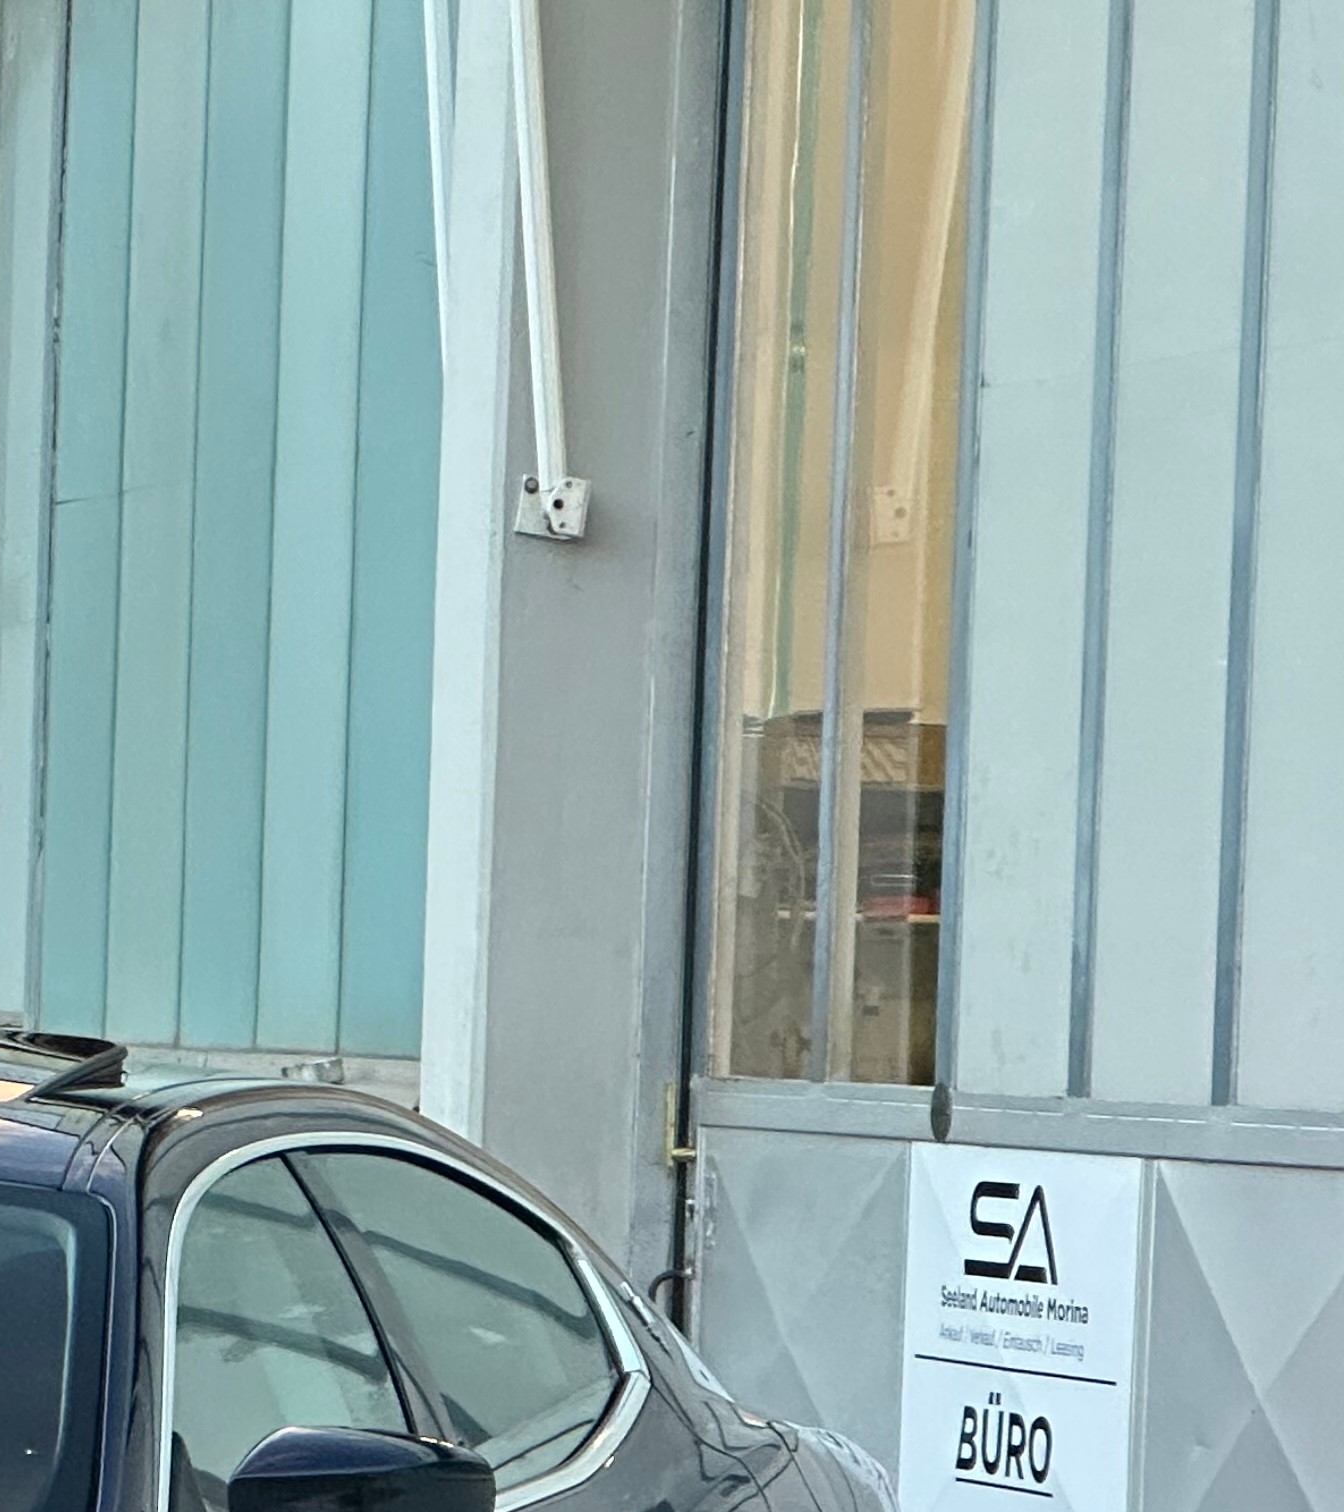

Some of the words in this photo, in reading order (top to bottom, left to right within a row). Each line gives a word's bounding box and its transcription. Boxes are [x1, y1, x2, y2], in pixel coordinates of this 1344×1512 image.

[964, 1181, 1058, 1285] SA
[940, 1285, 978, 1311] Seeland
[979, 1289, 1044, 1318] Automobile
[1046, 1298, 1089, 1324] Morina
[955, 1392, 1054, 1485] BÜRO
